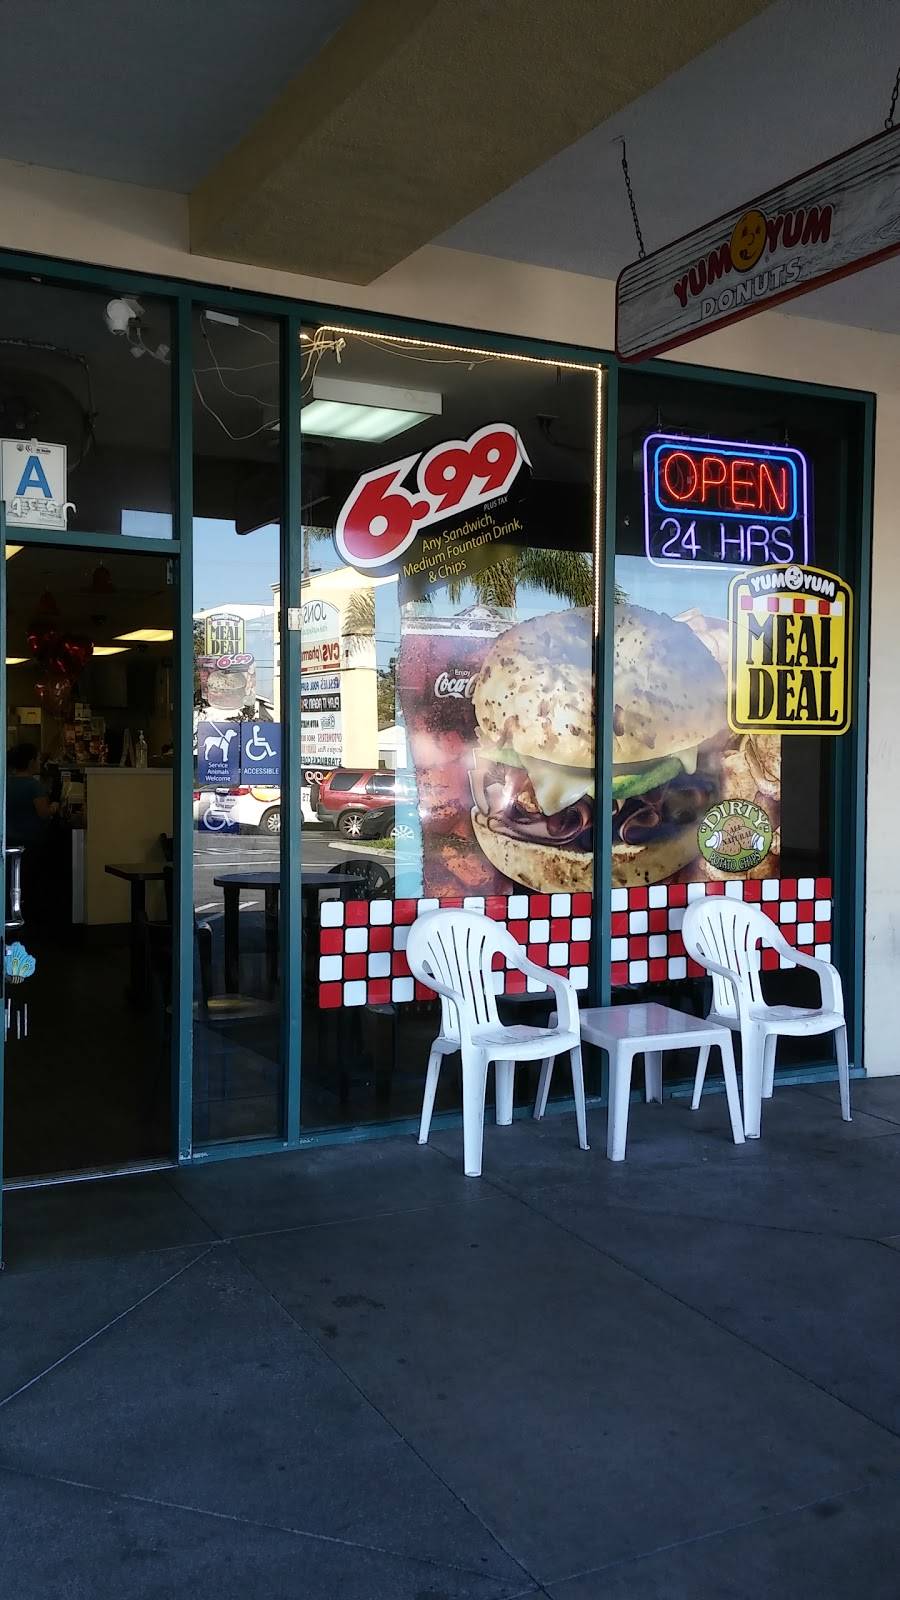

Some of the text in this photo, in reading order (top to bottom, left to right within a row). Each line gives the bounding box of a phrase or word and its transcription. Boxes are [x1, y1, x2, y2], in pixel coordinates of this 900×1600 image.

[673, 205, 833, 308] YUM YUM
[701, 256, 801, 310] DONUTS
[16, 455, 52, 498] A
[344, 432, 518, 559] 6.99
[664, 452, 786, 511] OPEN
[483, 496, 509, 511] PLUS TAX
[403, 518, 524, 577] Medium Fountain Drink,
[422, 513, 496, 552] Any Sandwich,
[659, 517, 794, 564] 24 HRS
[428, 559, 467, 583] & Chips
[750, 573, 835, 597] YUM YUM
[210, 625, 241, 640] MEAL
[746, 613, 838, 667] MEAL
[454, 668, 470, 676] Enjoy
[747, 667, 838, 722] DEAL
[709, 851, 761, 870] POTATO CHIPS
